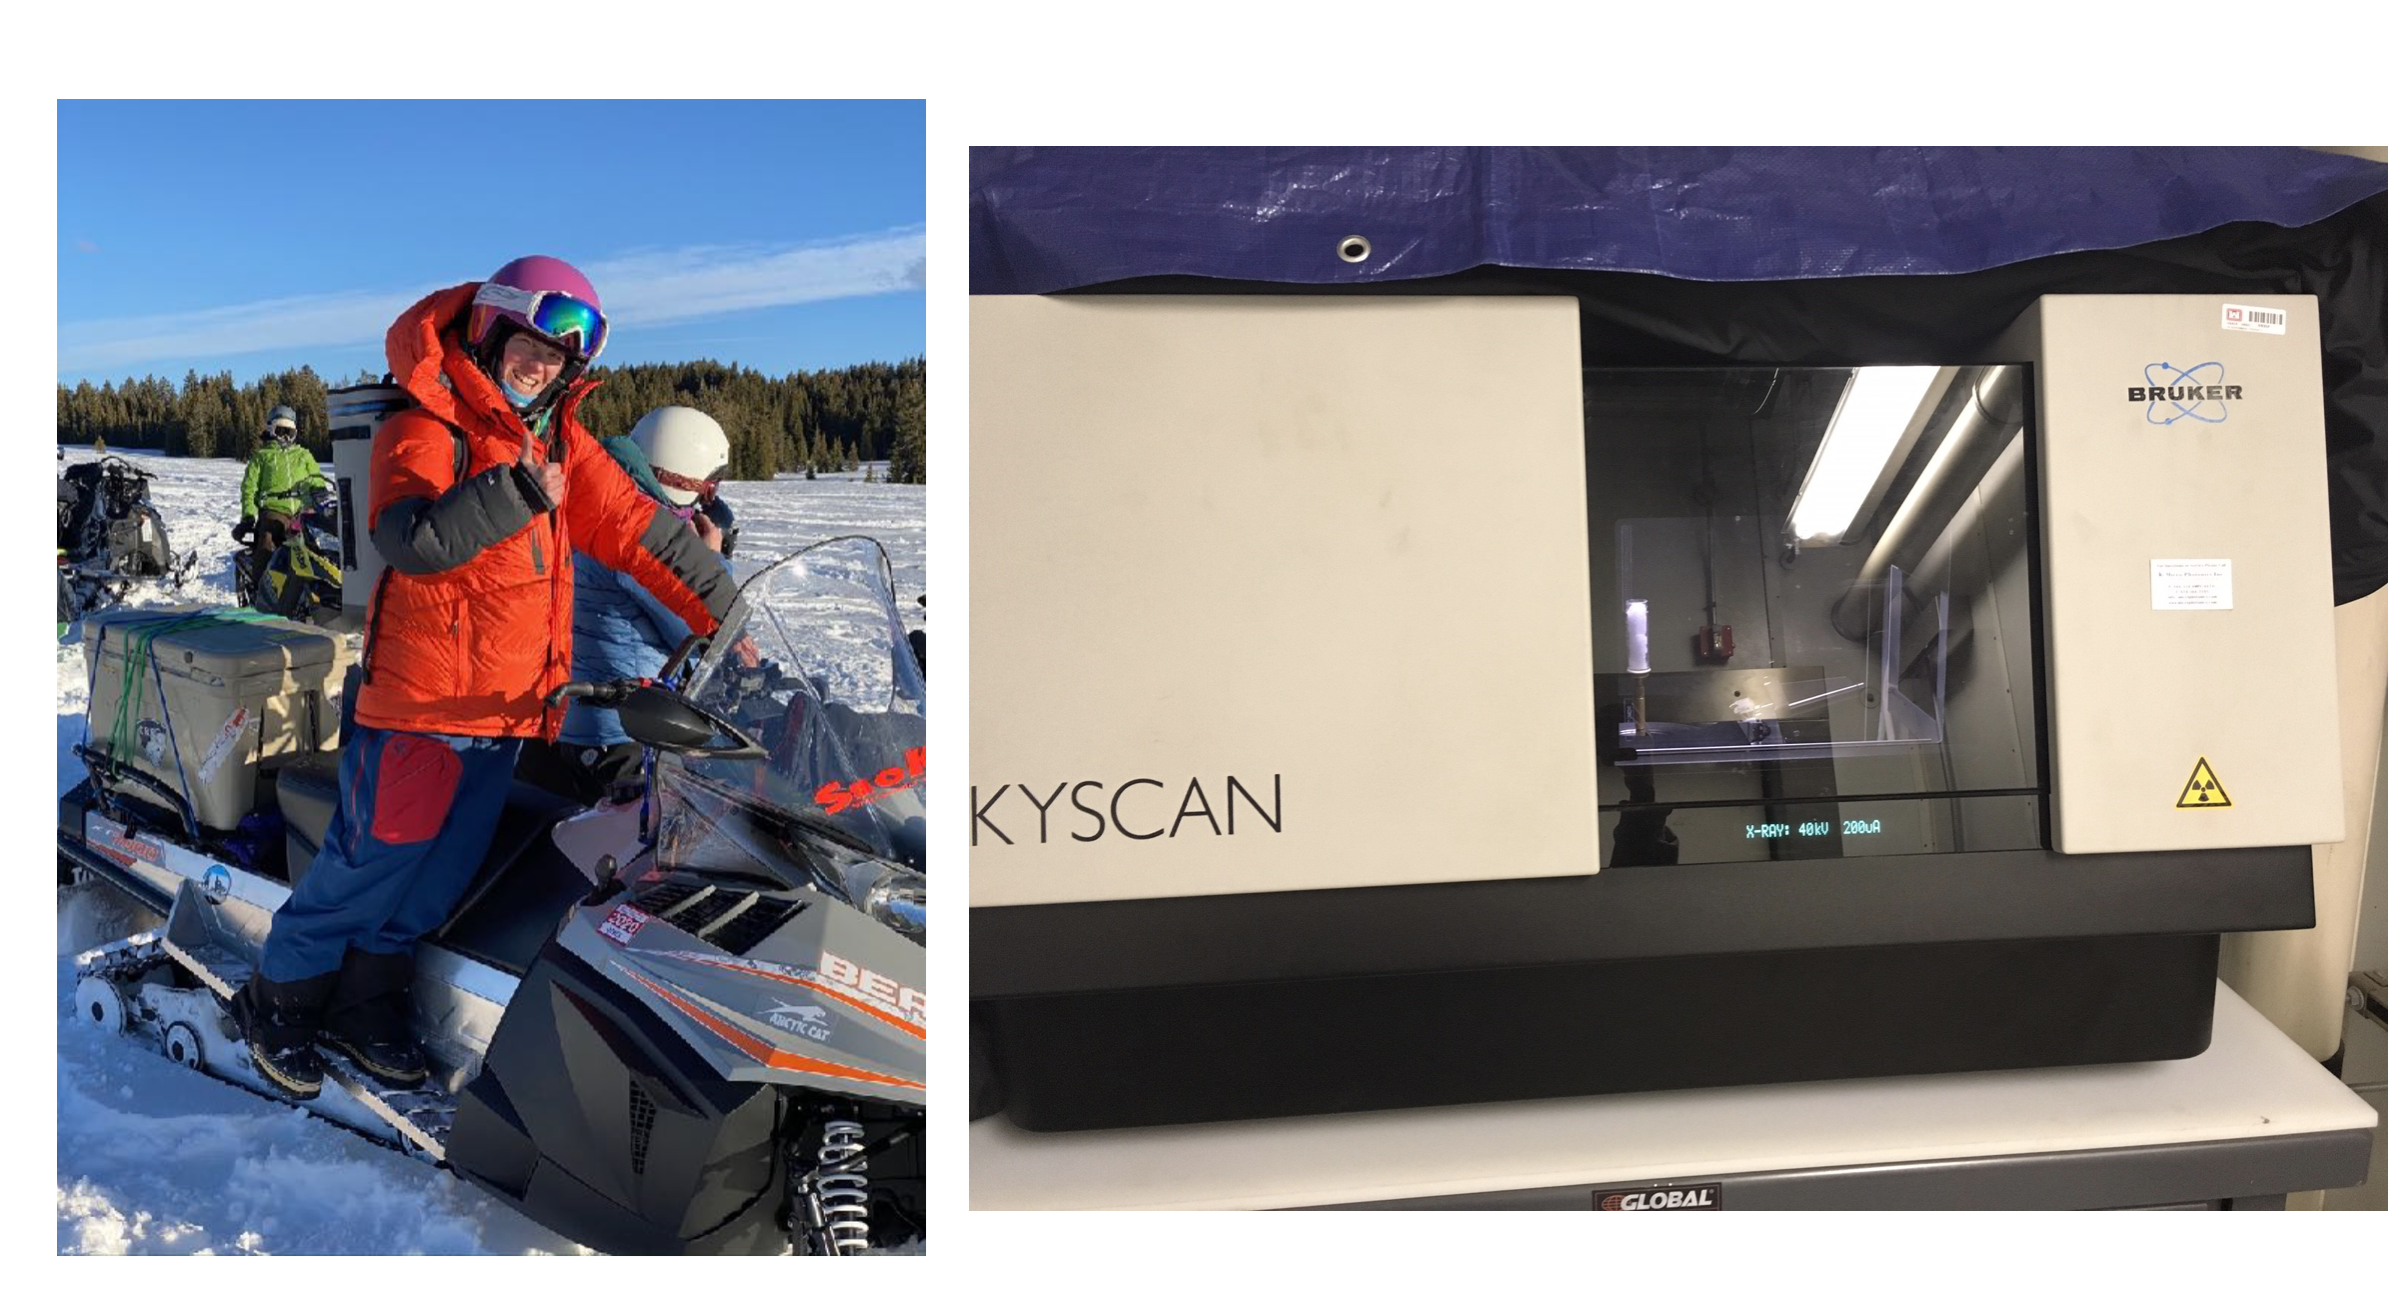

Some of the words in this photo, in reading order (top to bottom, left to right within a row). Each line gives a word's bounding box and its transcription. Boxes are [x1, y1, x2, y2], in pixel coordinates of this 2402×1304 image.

[2128, 385, 2243, 402] BRUKER
[971, 774, 1282, 846] KYSCAN
[1746, 823, 1790, 838] X-RAY:
[1798, 821, 1829, 836] 40kV
[769, 1013, 807, 1036] ARCTIC
[807, 1025, 831, 1042] CAT
[1621, 1189, 1712, 1210] GLOBAL
